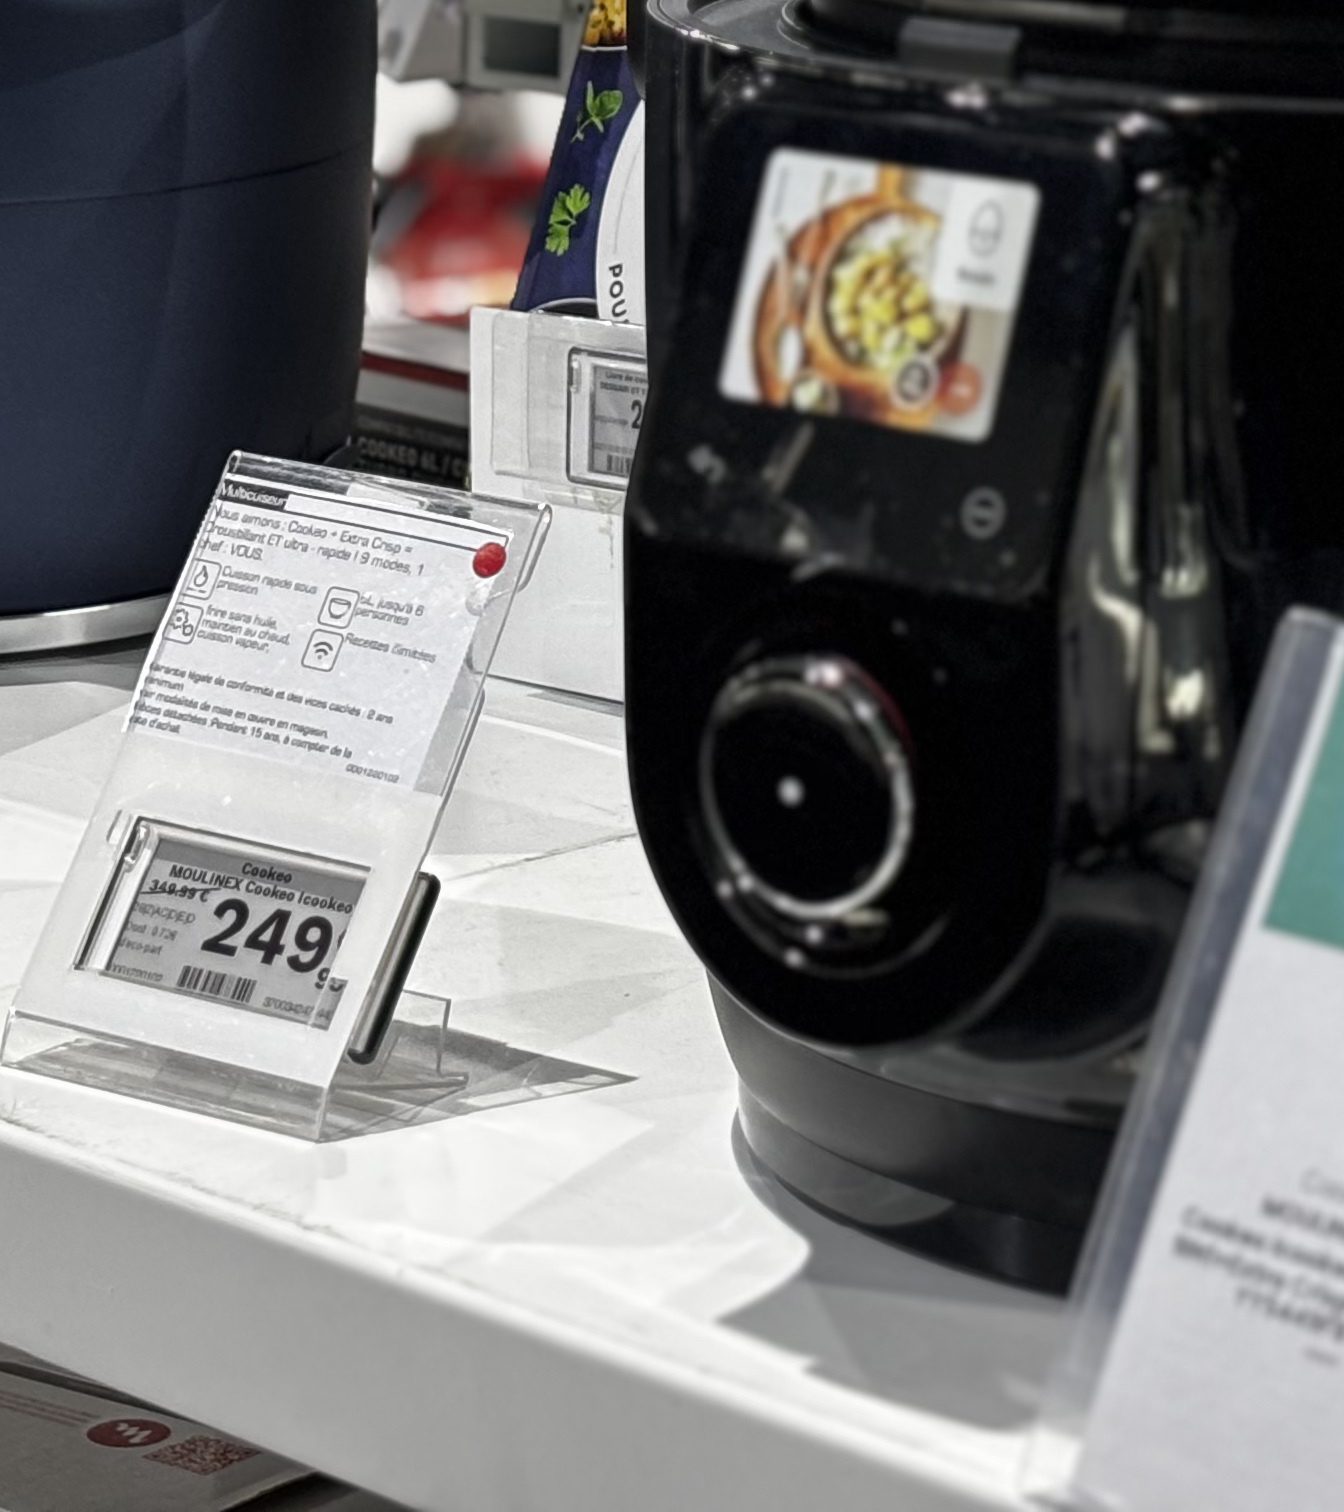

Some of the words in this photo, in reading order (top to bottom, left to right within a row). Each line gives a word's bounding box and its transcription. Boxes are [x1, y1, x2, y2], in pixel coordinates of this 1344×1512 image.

[609, 263, 629, 323] POU
[287, 520, 328, 538] Cookeo
[169, 863, 244, 891] MOULINEX
[245, 880, 296, 902] Cookeo
[241, 862, 293, 883] Cookeo
[200, 898, 334, 974] 249
